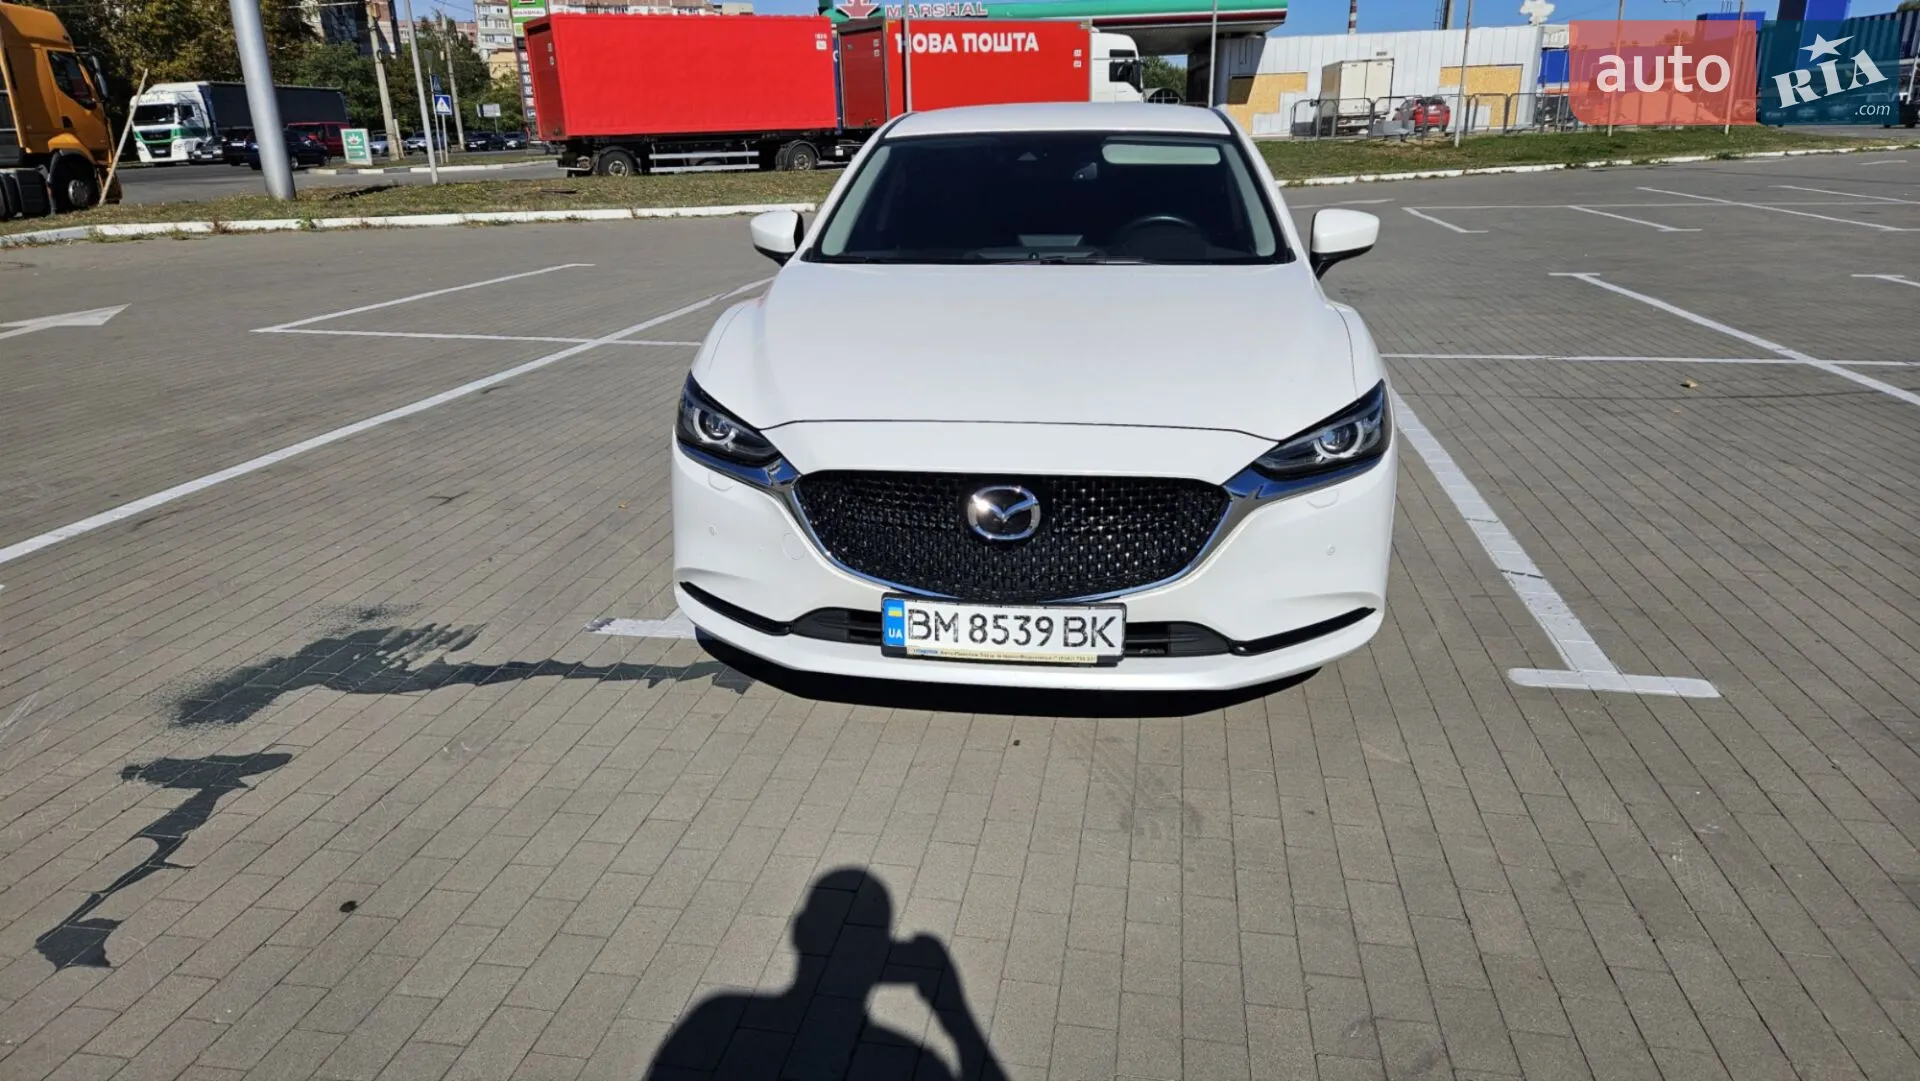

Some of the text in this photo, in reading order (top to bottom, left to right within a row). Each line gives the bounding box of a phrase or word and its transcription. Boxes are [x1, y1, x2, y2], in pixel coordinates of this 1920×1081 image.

[885, 1, 988, 18] MARSHAL
[962, 32, 1039, 52] ПОШТА
[888, 628, 903, 639] UA
[908, 608, 1117, 648] BM 8539 BK
